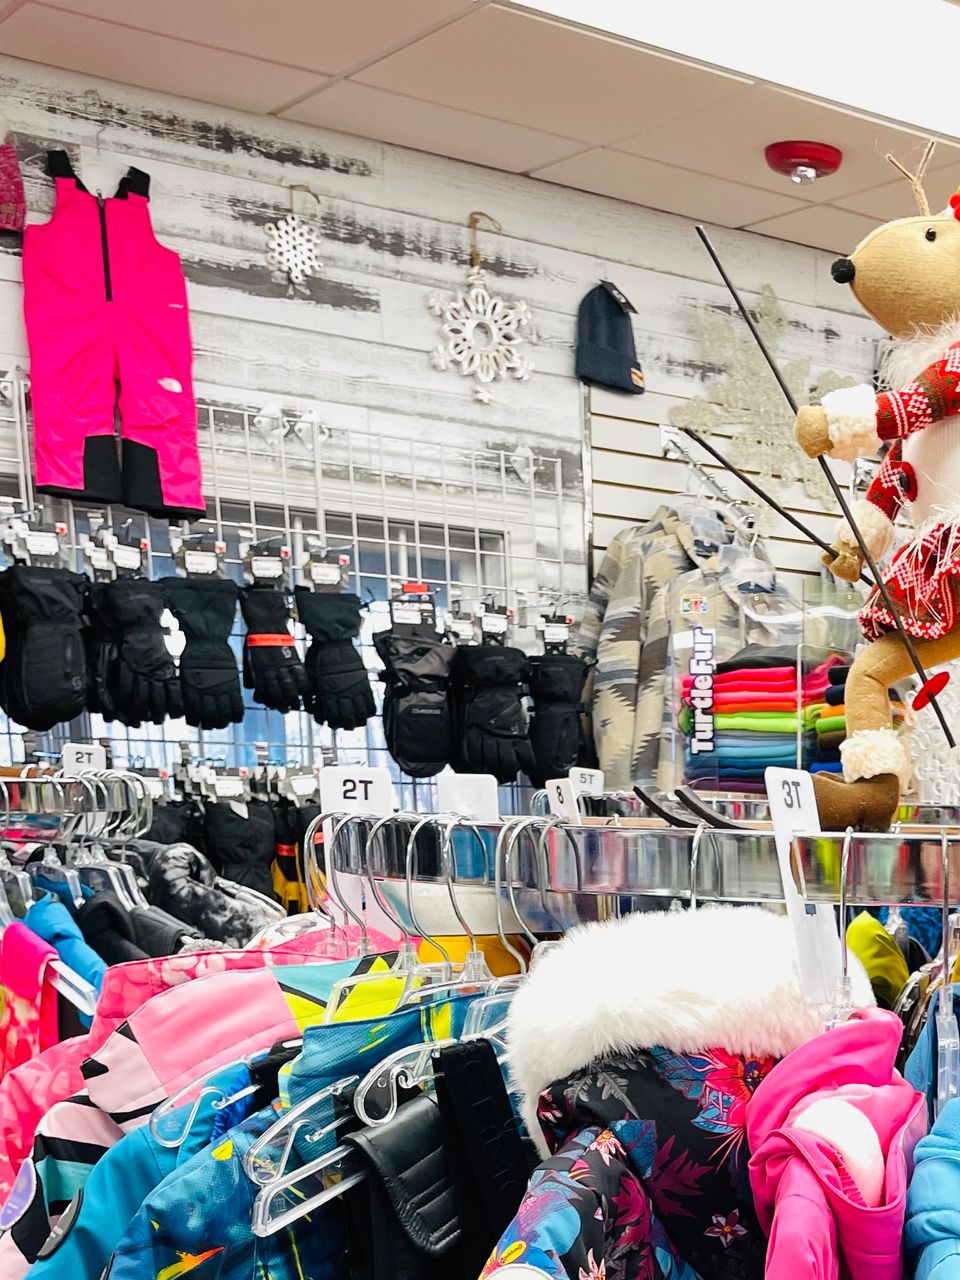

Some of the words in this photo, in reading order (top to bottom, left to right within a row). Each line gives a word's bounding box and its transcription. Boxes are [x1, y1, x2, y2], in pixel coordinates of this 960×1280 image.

[75, 751, 93, 764] 2T
[579, 772, 595, 785] 5T
[342, 778, 374, 801] 2T
[555, 785, 565, 805] 8
[781, 779, 801, 809] 3T
